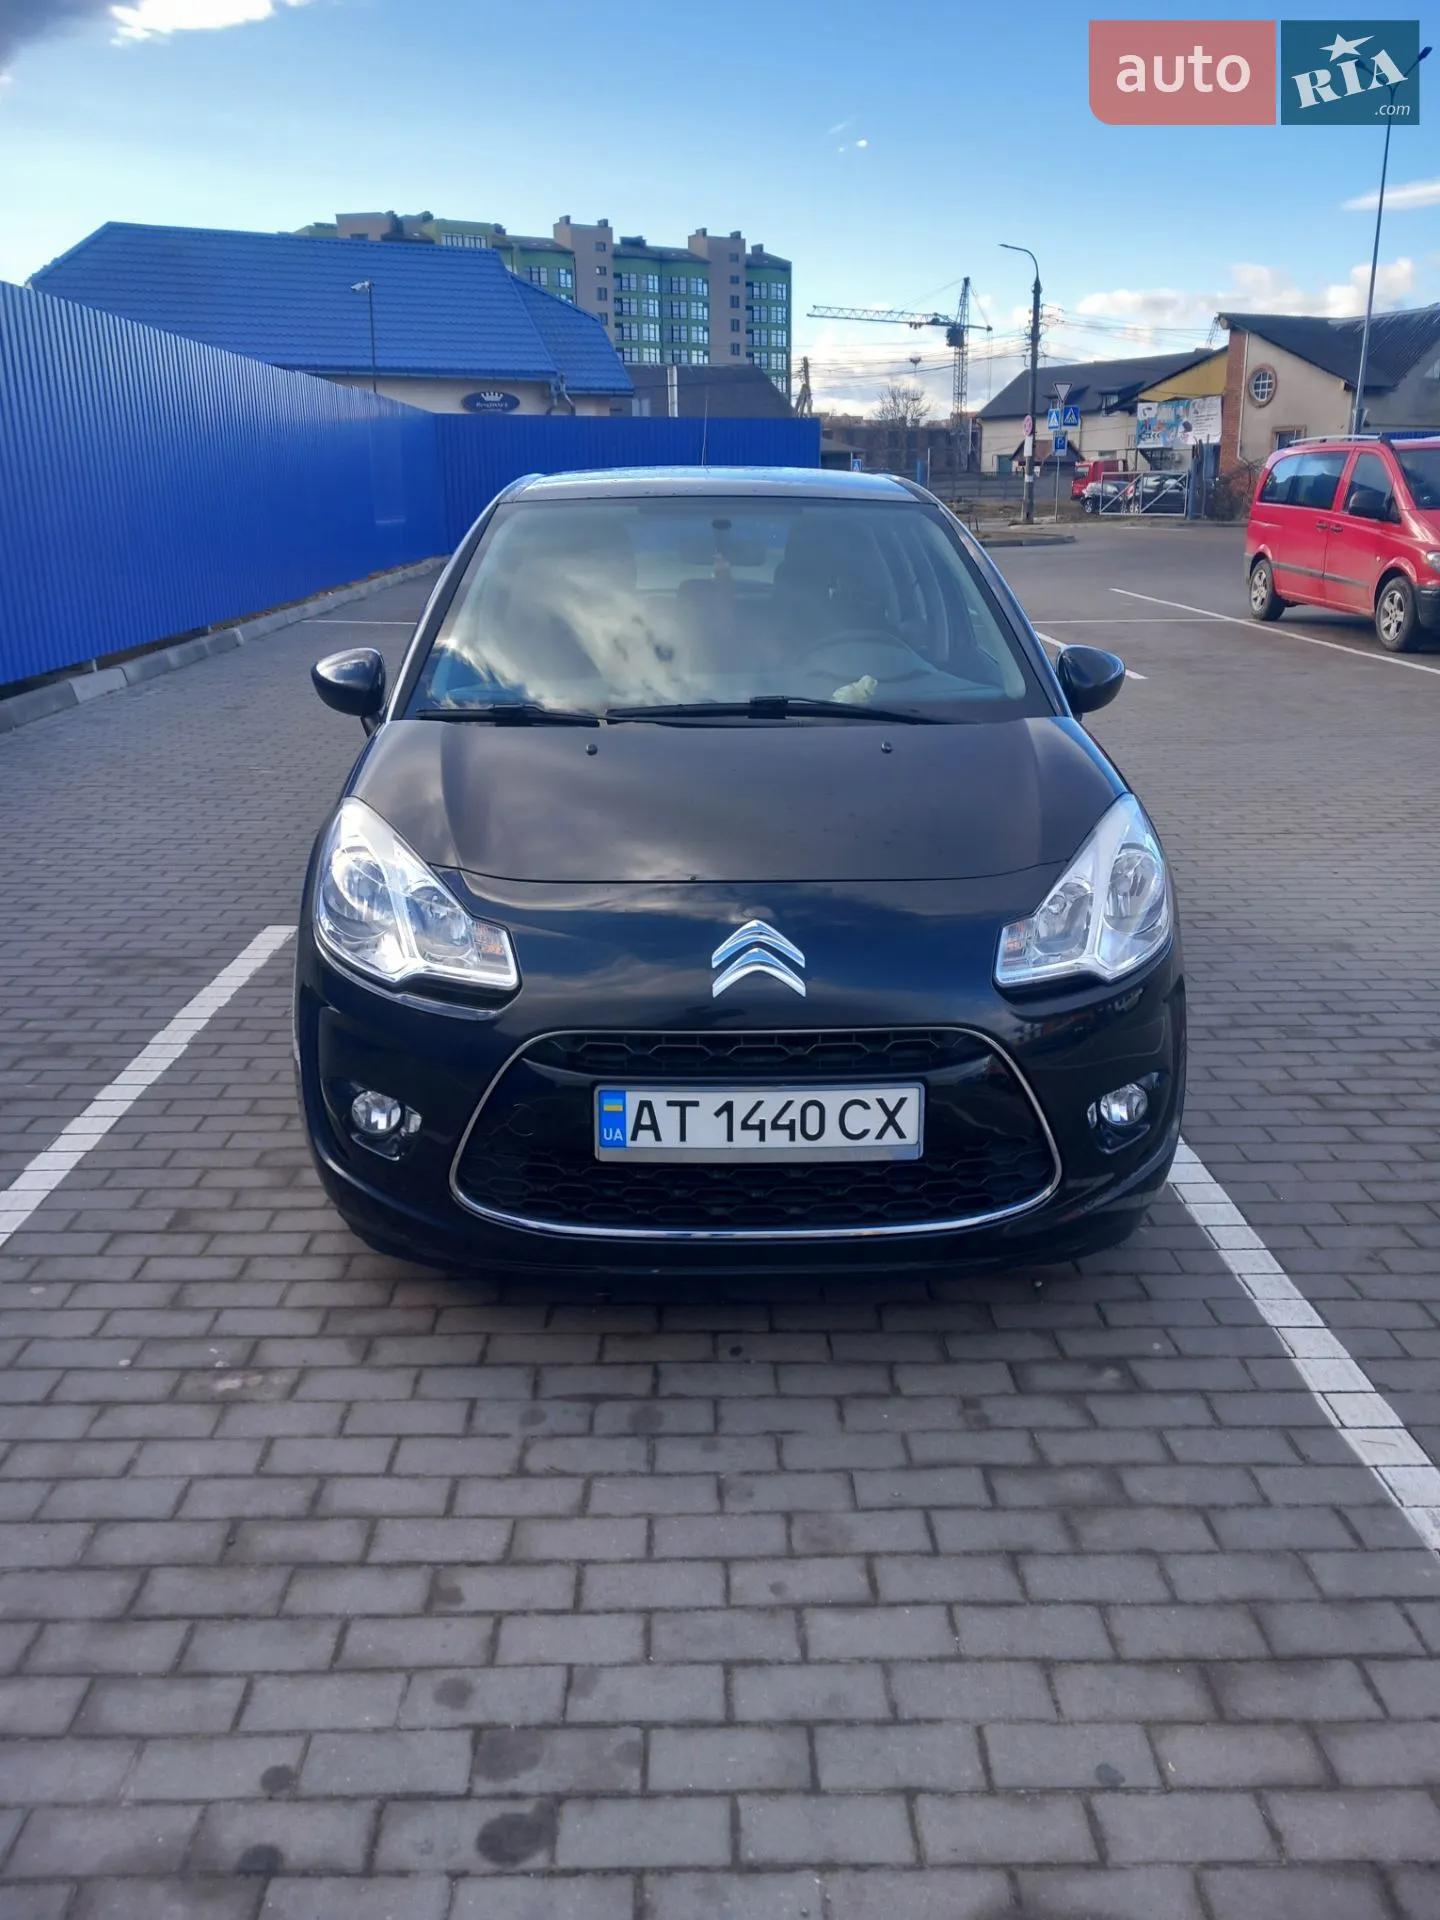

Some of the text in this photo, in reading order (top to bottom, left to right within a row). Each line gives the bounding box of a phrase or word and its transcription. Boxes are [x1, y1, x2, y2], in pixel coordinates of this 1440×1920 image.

[630, 1097, 909, 1142] AT 1440 CX
[603, 1128, 624, 1142] UA
